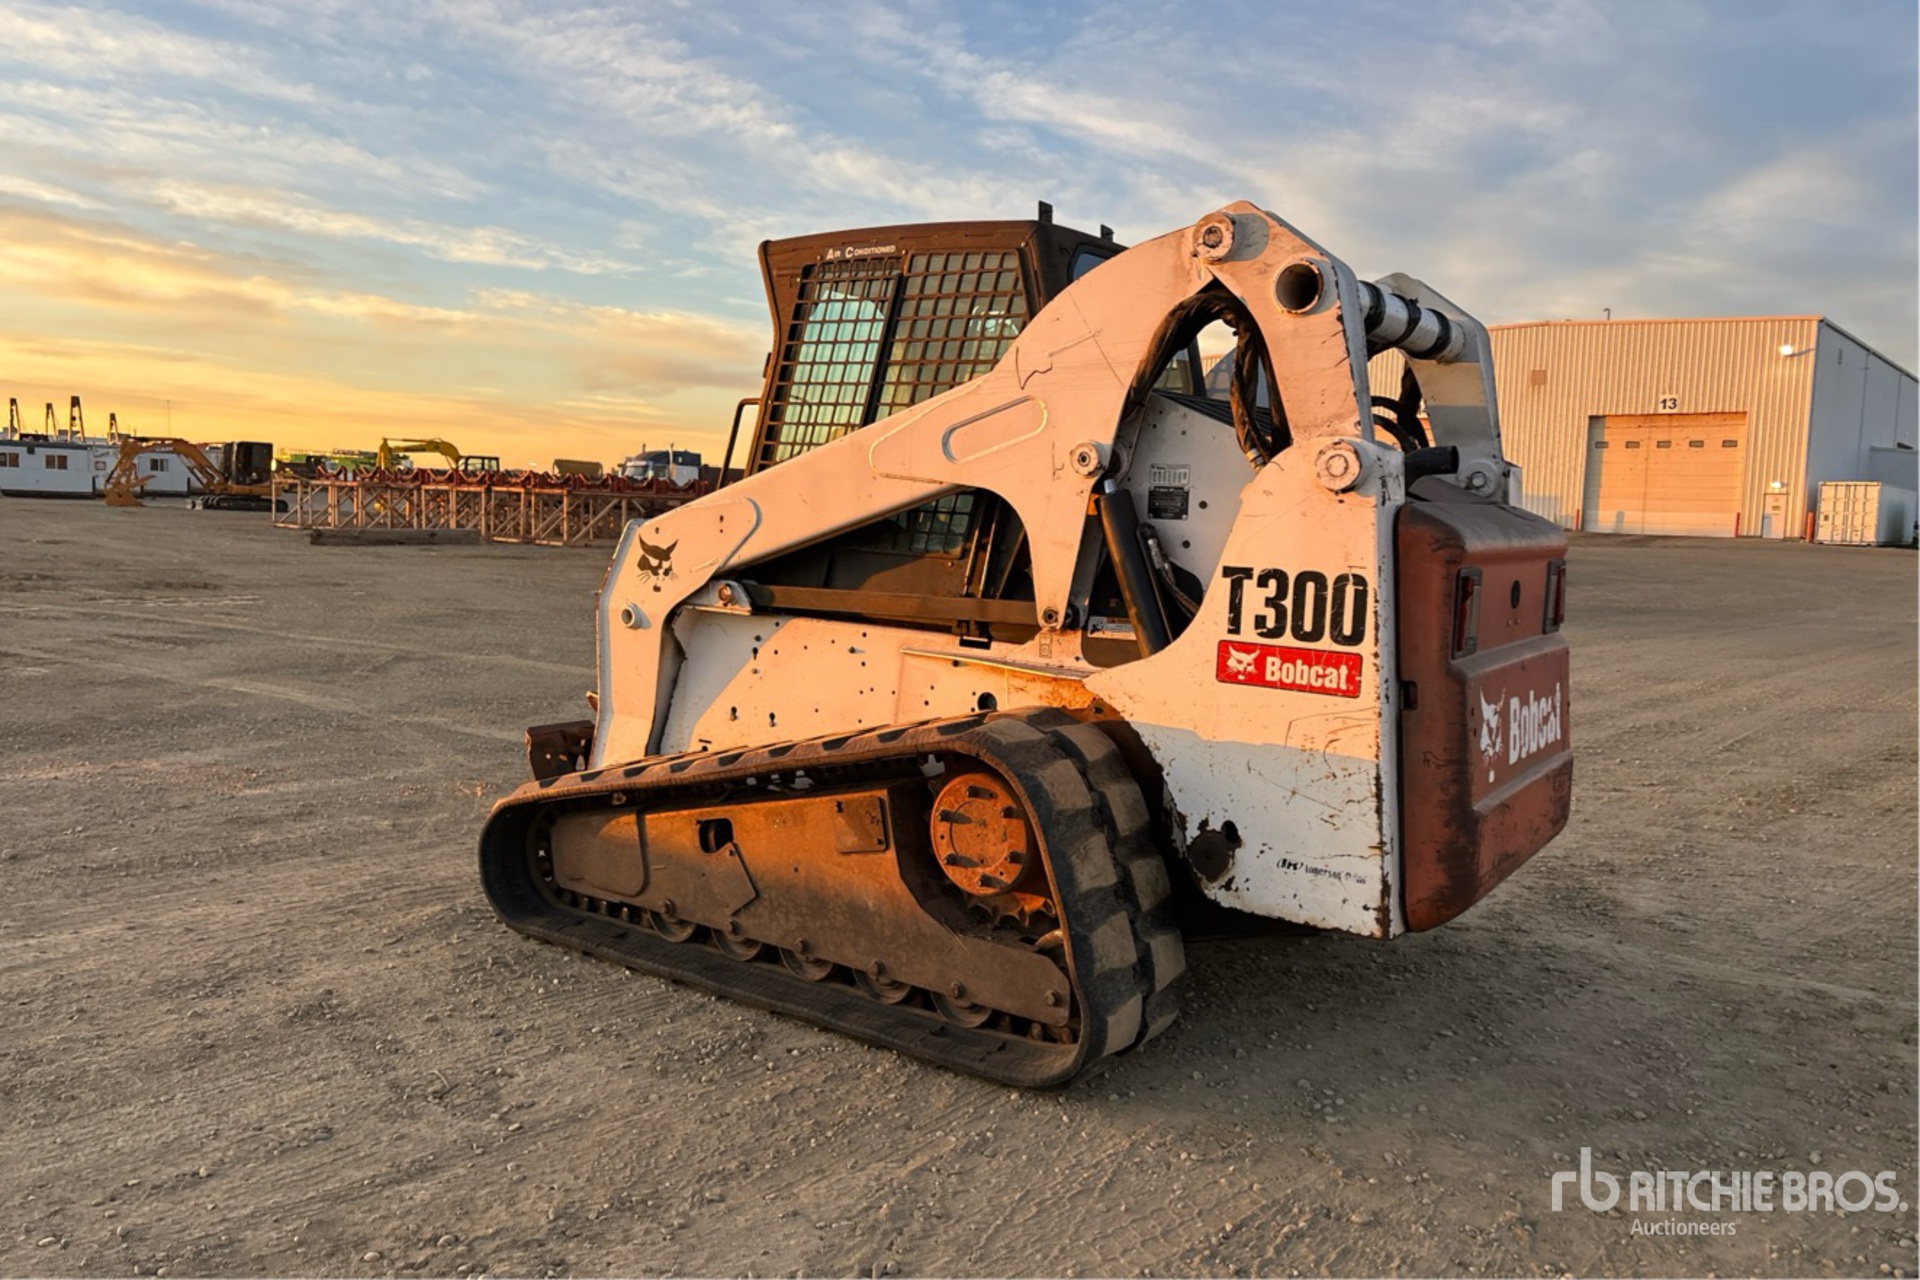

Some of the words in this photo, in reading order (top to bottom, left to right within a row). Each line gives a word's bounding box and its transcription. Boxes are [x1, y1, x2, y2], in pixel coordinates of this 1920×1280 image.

[1660, 397, 1677, 410] 13
[1222, 565, 1369, 647] T300
[1265, 656, 1349, 690] Bobcat
